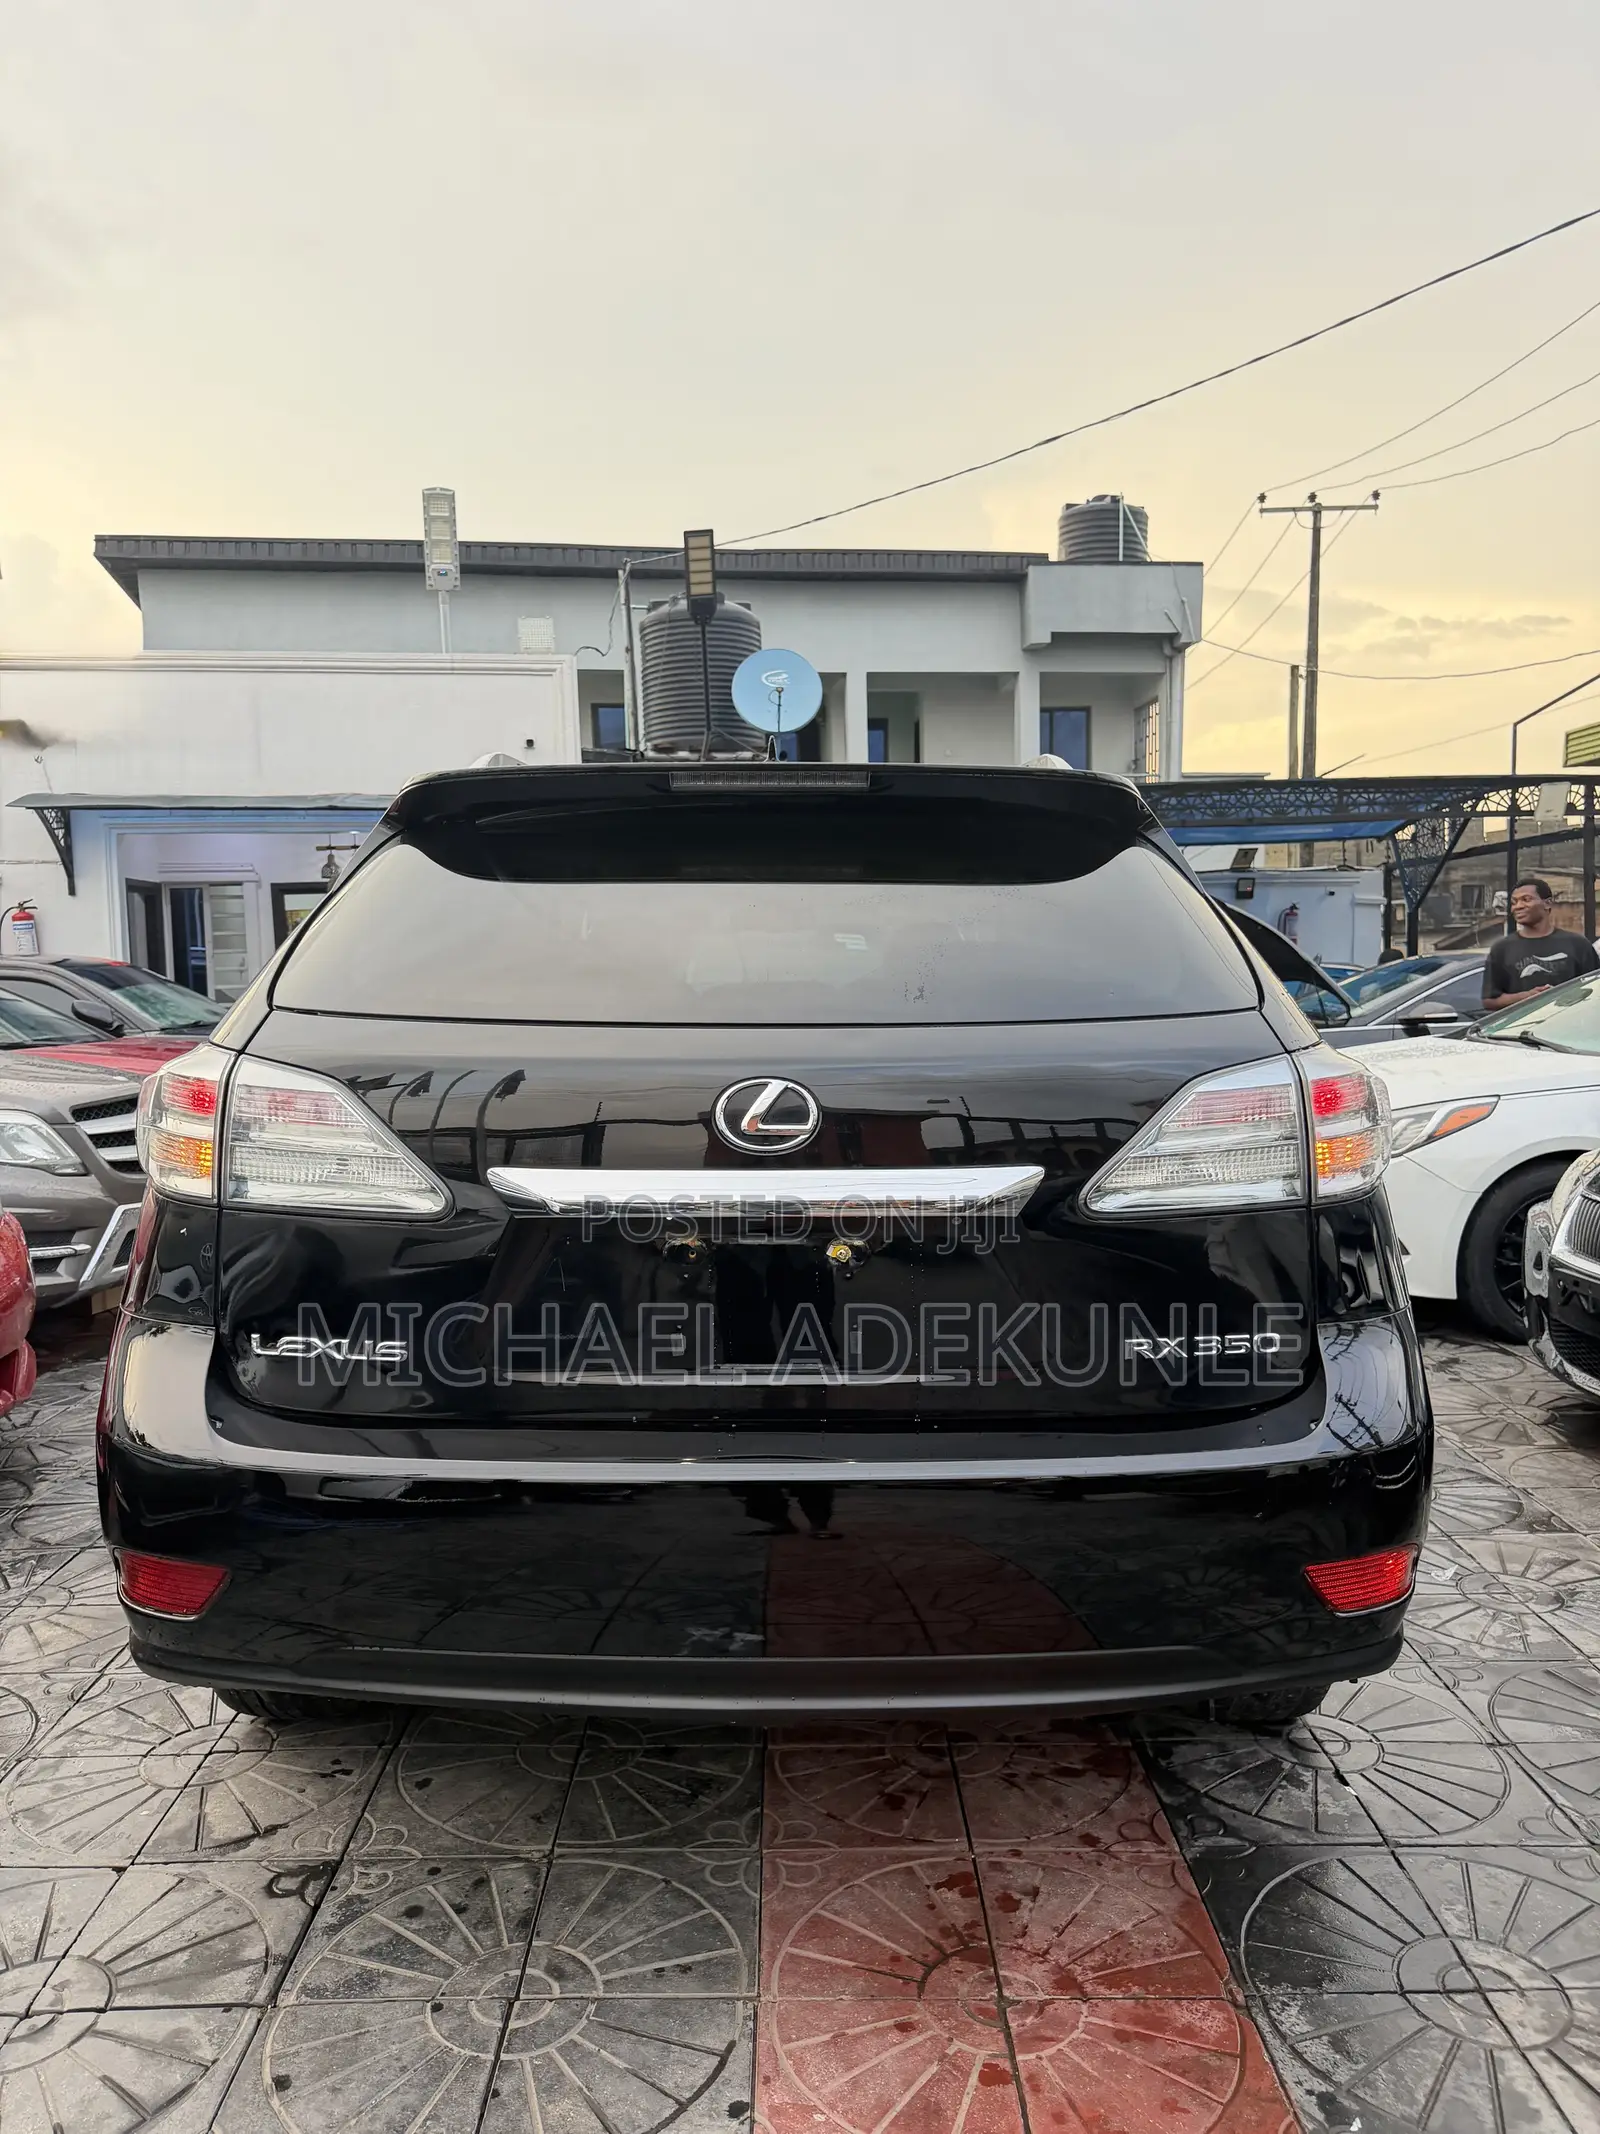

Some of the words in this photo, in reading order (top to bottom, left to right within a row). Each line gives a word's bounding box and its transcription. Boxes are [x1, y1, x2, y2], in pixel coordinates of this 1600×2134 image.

[251, 1334, 408, 1361] LEXUS
[1125, 1337, 1188, 1360] RX
[1194, 1333, 1280, 1356] 350
